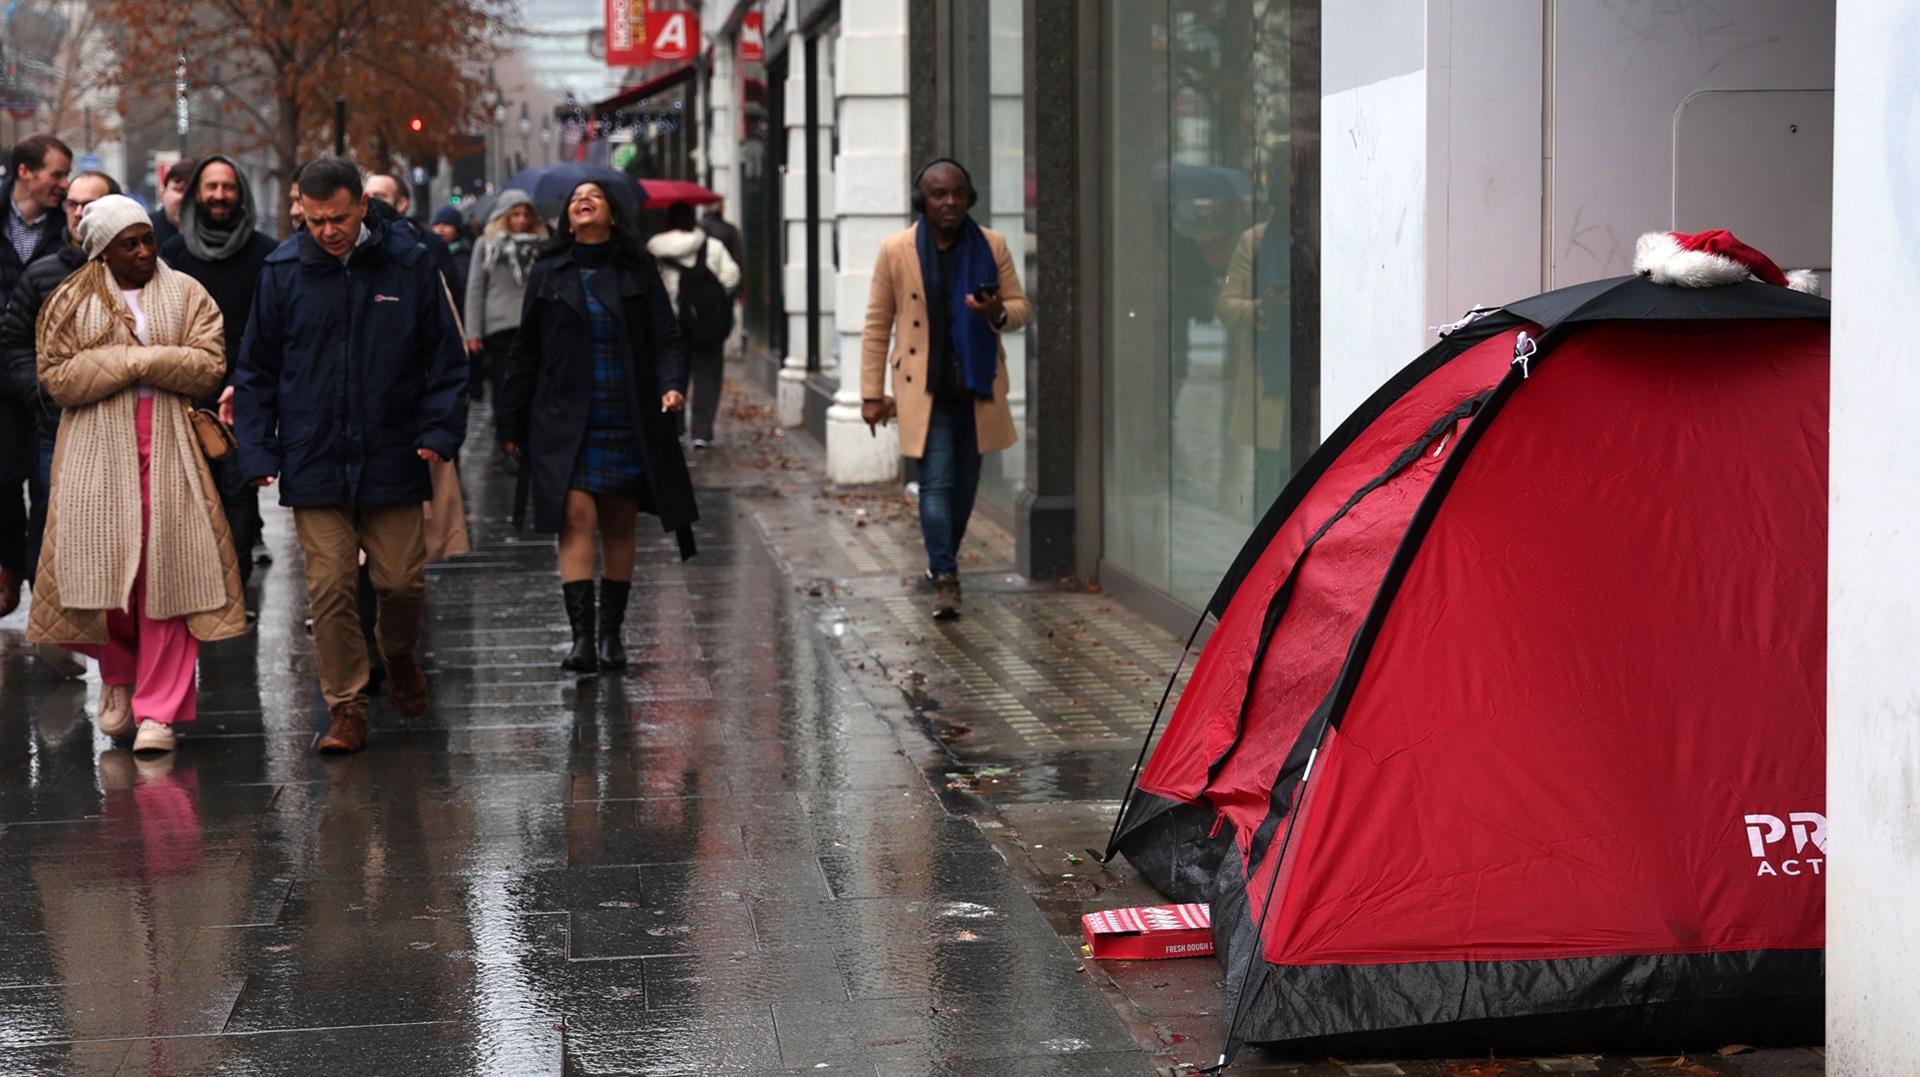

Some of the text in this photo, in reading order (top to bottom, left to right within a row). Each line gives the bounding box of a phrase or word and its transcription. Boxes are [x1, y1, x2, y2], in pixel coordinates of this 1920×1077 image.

[653, 13, 688, 50] A
[1756, 858, 1823, 876] ACT
[1165, 944, 1186, 954] FRESH
[1186, 942, 1209, 952] DOUGH
